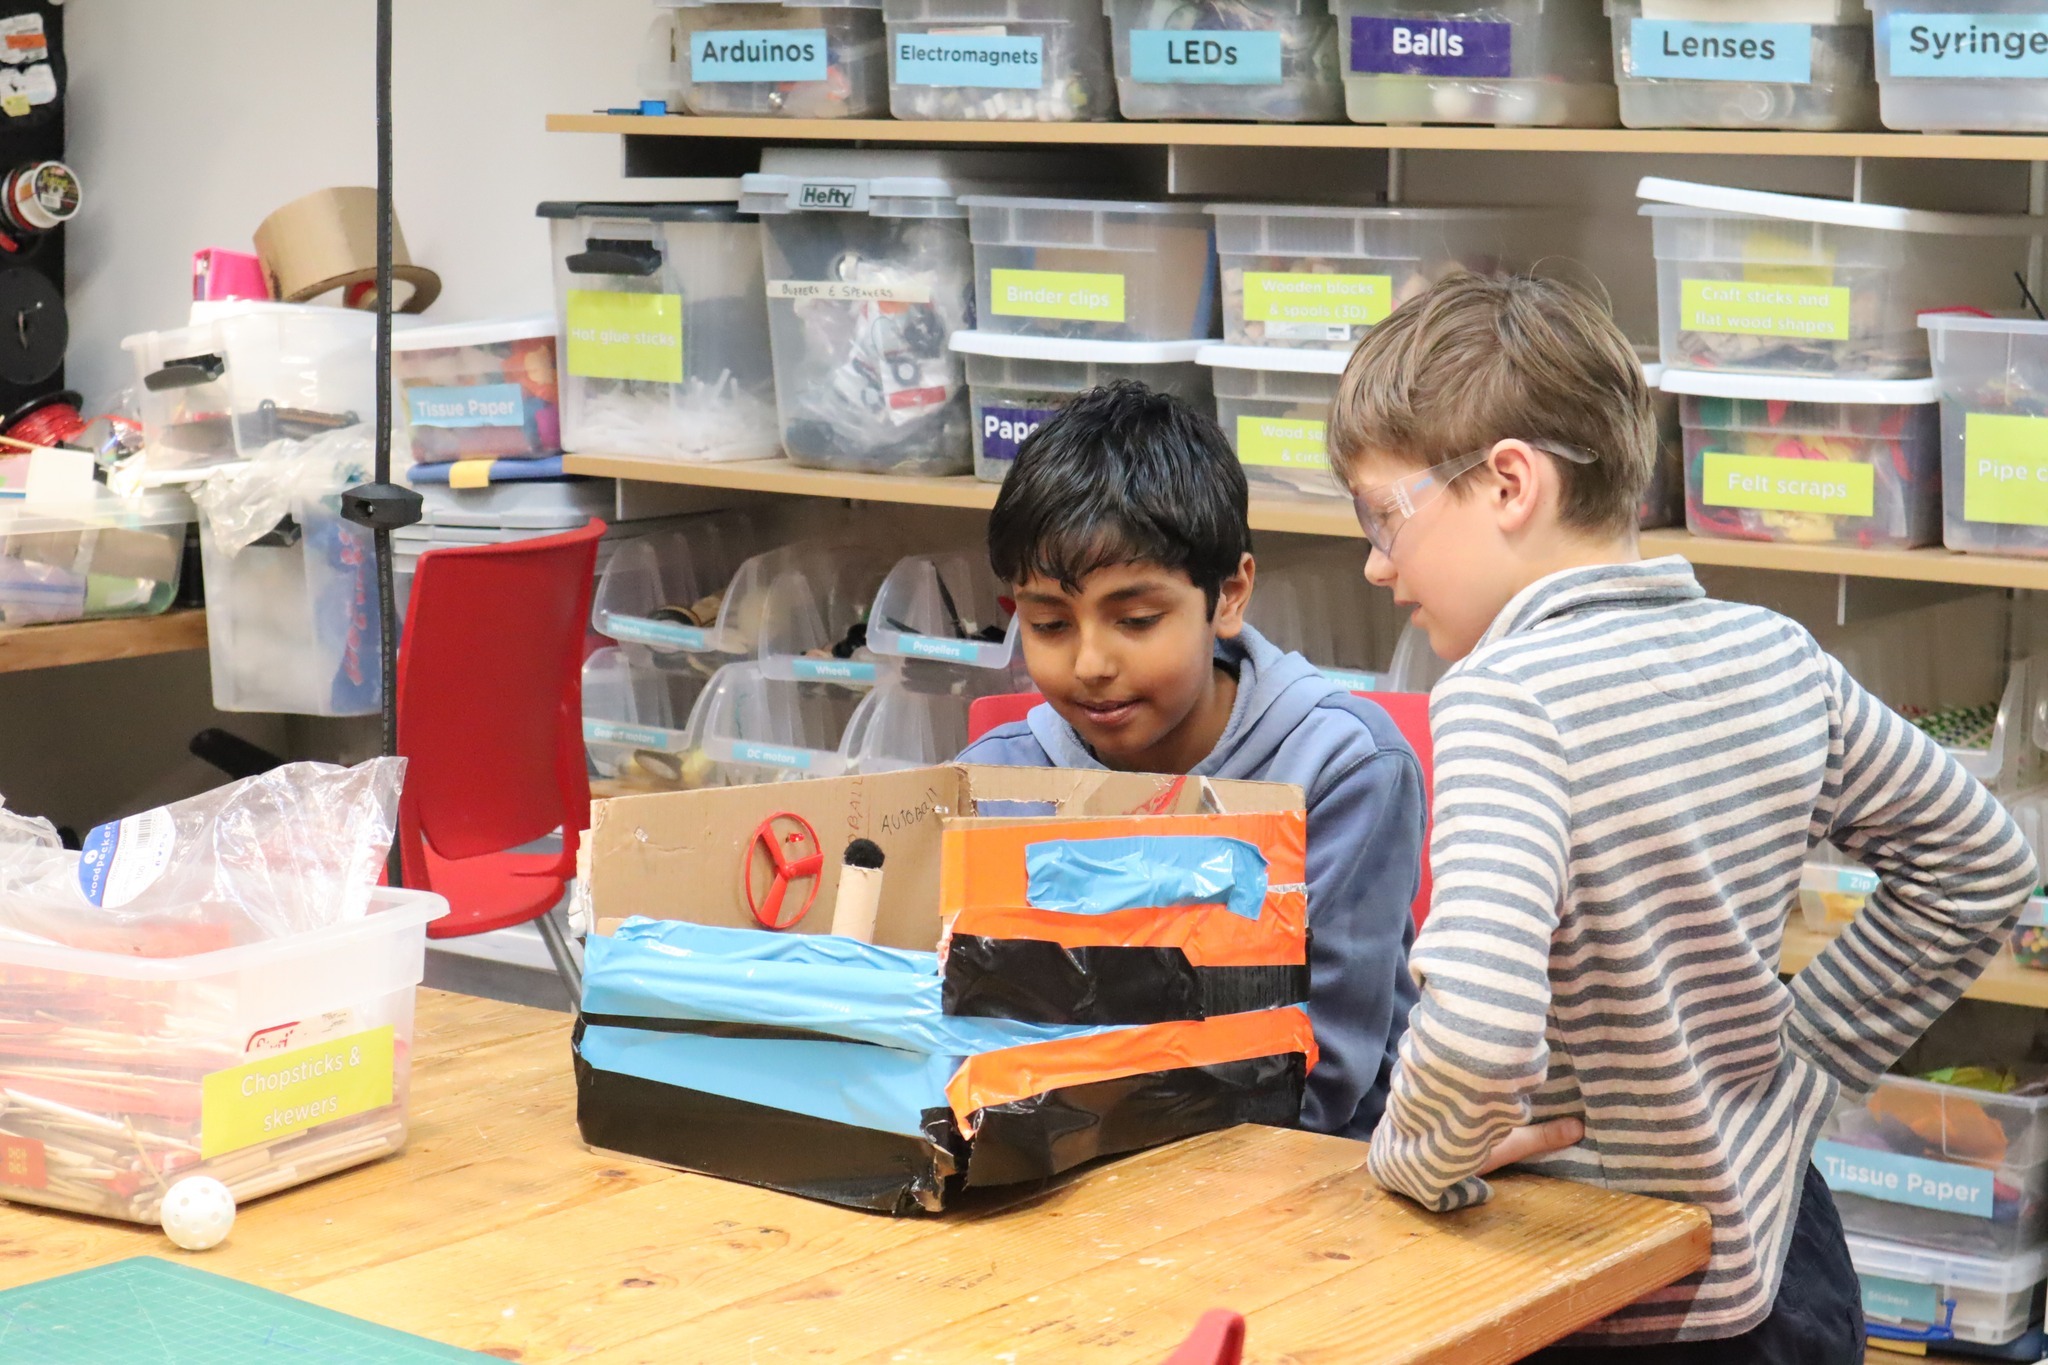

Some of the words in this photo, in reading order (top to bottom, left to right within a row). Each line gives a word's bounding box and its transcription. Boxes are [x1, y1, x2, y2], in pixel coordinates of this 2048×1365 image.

[702, 39, 814, 63] Arduinos
[1167, 40, 1238, 65] LEDs
[1392, 27, 1464, 57] Balls
[1662, 30, 1776, 60] Lenses
[901, 45, 1038, 66] Electromagnets
[803, 187, 853, 208] Hefty
[1007, 285, 1064, 304] Binder
[1069, 289, 1111, 309] clips
[1261, 278, 1323, 294] Wooden
[1326, 280, 1376, 297] blocks
[1701, 286, 1742, 303] Craft
[1746, 289, 1794, 306] sticks
[1798, 293, 1831, 307] and
[1269, 301, 1279, 316] &
[1283, 304, 1331, 319] spools
[1334, 304, 1369, 320] (3D)
[1695, 309, 1723, 327] flat
[1726, 315, 1772, 329] wood
[1777, 316, 1836, 334] shapes
[571, 327, 596, 341] Hot
[601, 330, 630, 345] glue
[634, 331, 676, 348] sticks
[417, 401, 465, 418] Tissue
[469, 400, 515, 418] Paper
[1260, 424, 1304, 440] Wood
[1978, 459, 2028, 482] Pipe
[1728, 472, 1769, 493] Felt
[1776, 478, 1847, 500] scraps
[913, 641, 961, 657] Propellers
[815, 664, 851, 677] Wheels
[626, 732, 656, 744] motors
[746, 748, 761, 761] DC
[763, 751, 796, 764] motors
[1850, 876, 1871, 891] Zip
[241, 1053, 343, 1097] Chopsticks
[349, 1046, 361, 1067] &
[263, 1094, 338, 1132] skewers
[1824, 1156, 1899, 1190] Tissue
[1906, 1173, 1981, 1203] Paper
